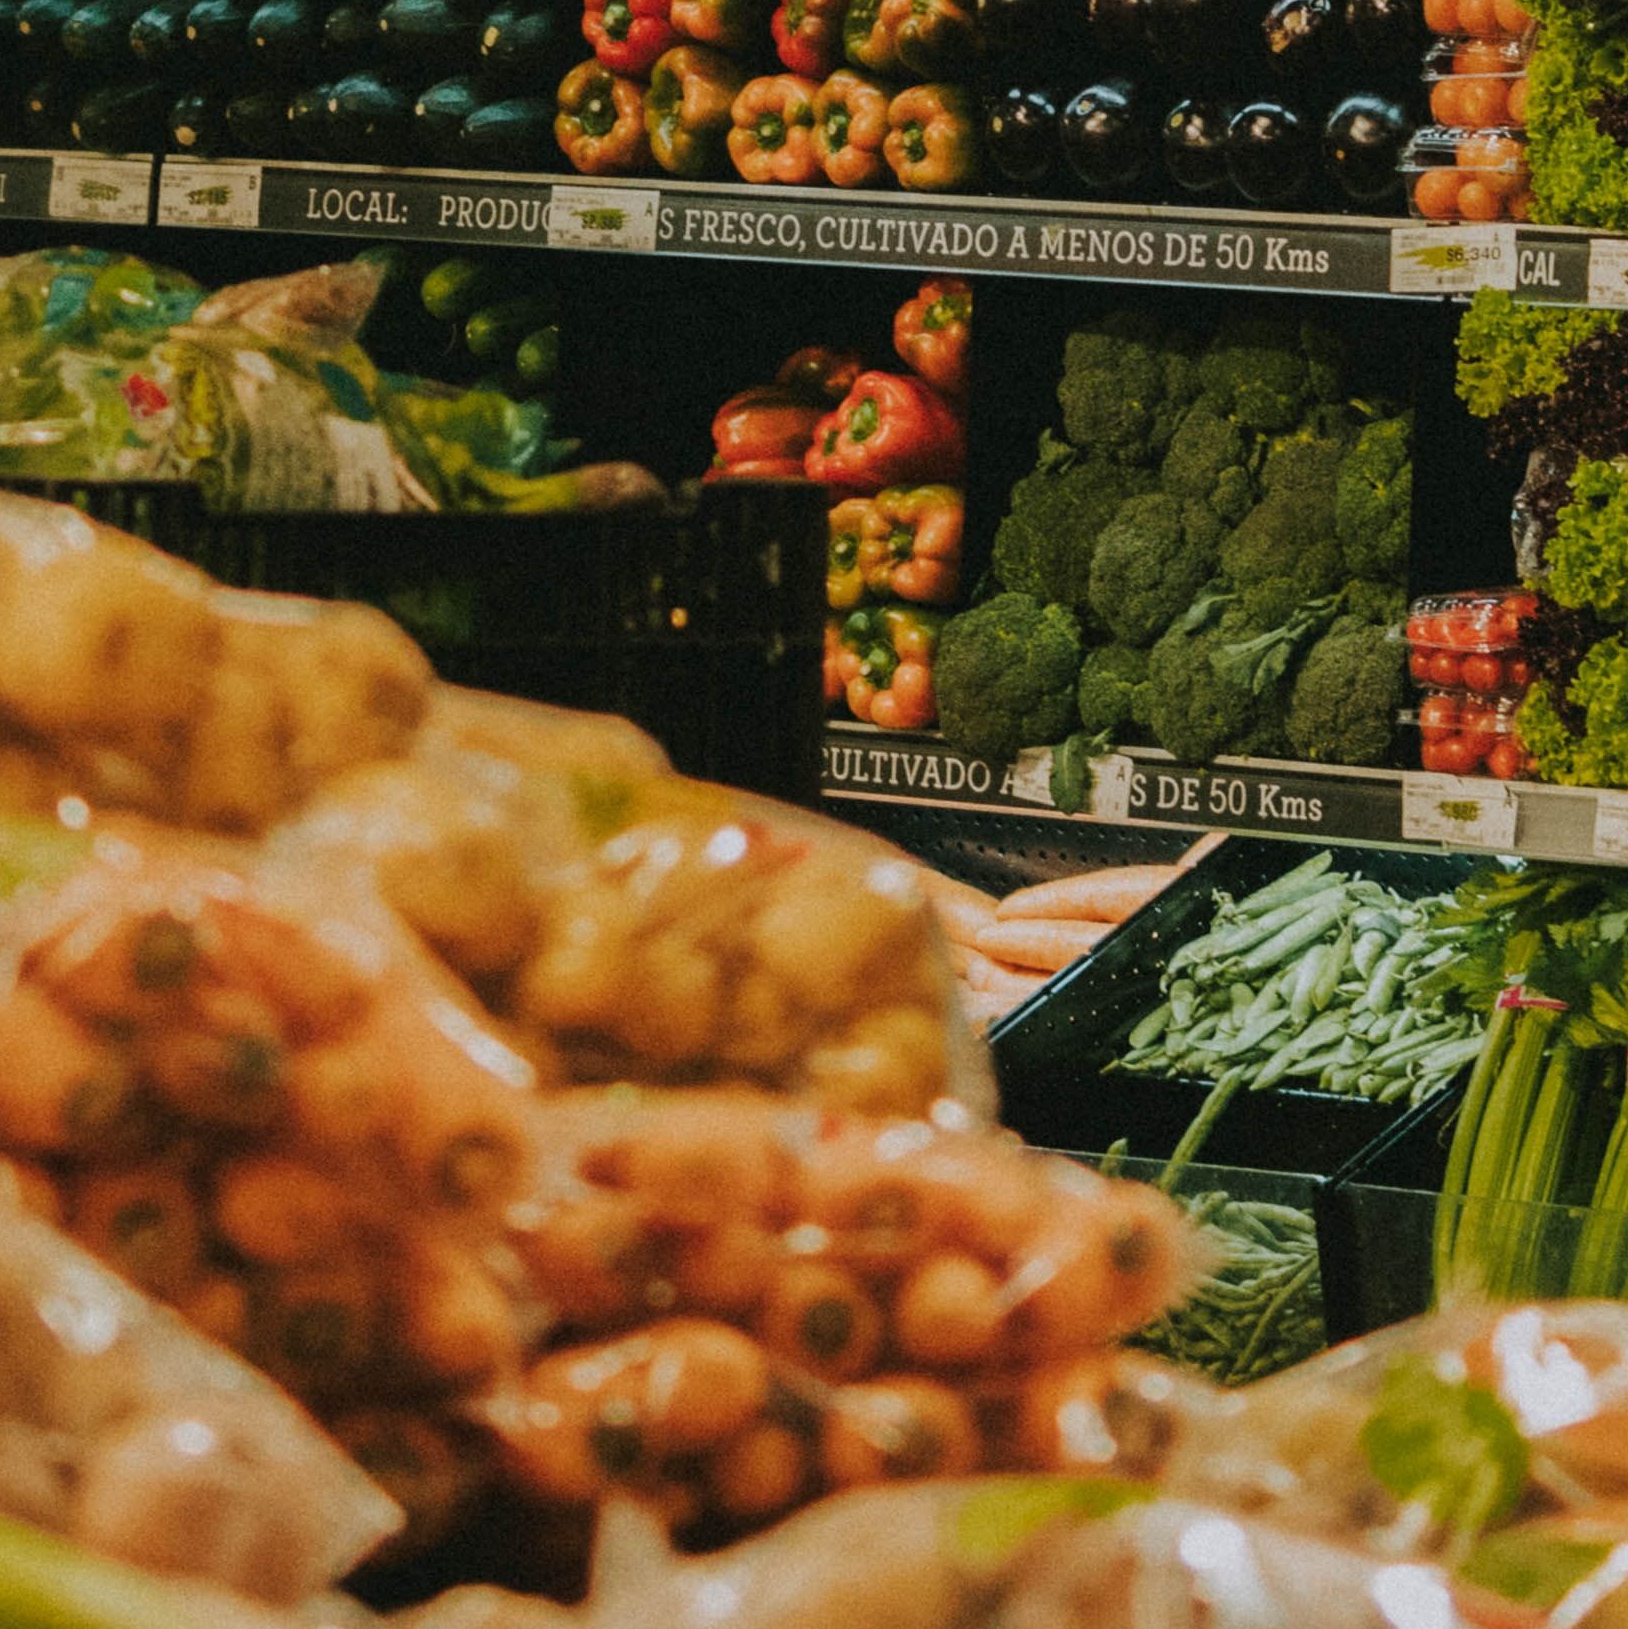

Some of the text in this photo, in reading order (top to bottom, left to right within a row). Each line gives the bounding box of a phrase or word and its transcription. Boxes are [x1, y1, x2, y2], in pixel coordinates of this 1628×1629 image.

[306, 187, 408, 224] LOCAL:
[683, 208, 807, 252] FRESCO,
[816, 216, 999, 258] CULTIVADO
[1006, 226, 1030, 260] A
[1038, 226, 1155, 265] MENOS
[1163, 232, 1207, 268] DE
[1216, 233, 1254, 270] 50
[1265, 237, 1330, 273] Kms
[1446, 246, 1502, 262] $6.340
[1519, 248, 1561, 287] CAL
[1156, 776, 1200, 812] DE
[1209, 778, 1247, 815] 50
[1258, 783, 1323, 822] Kms
